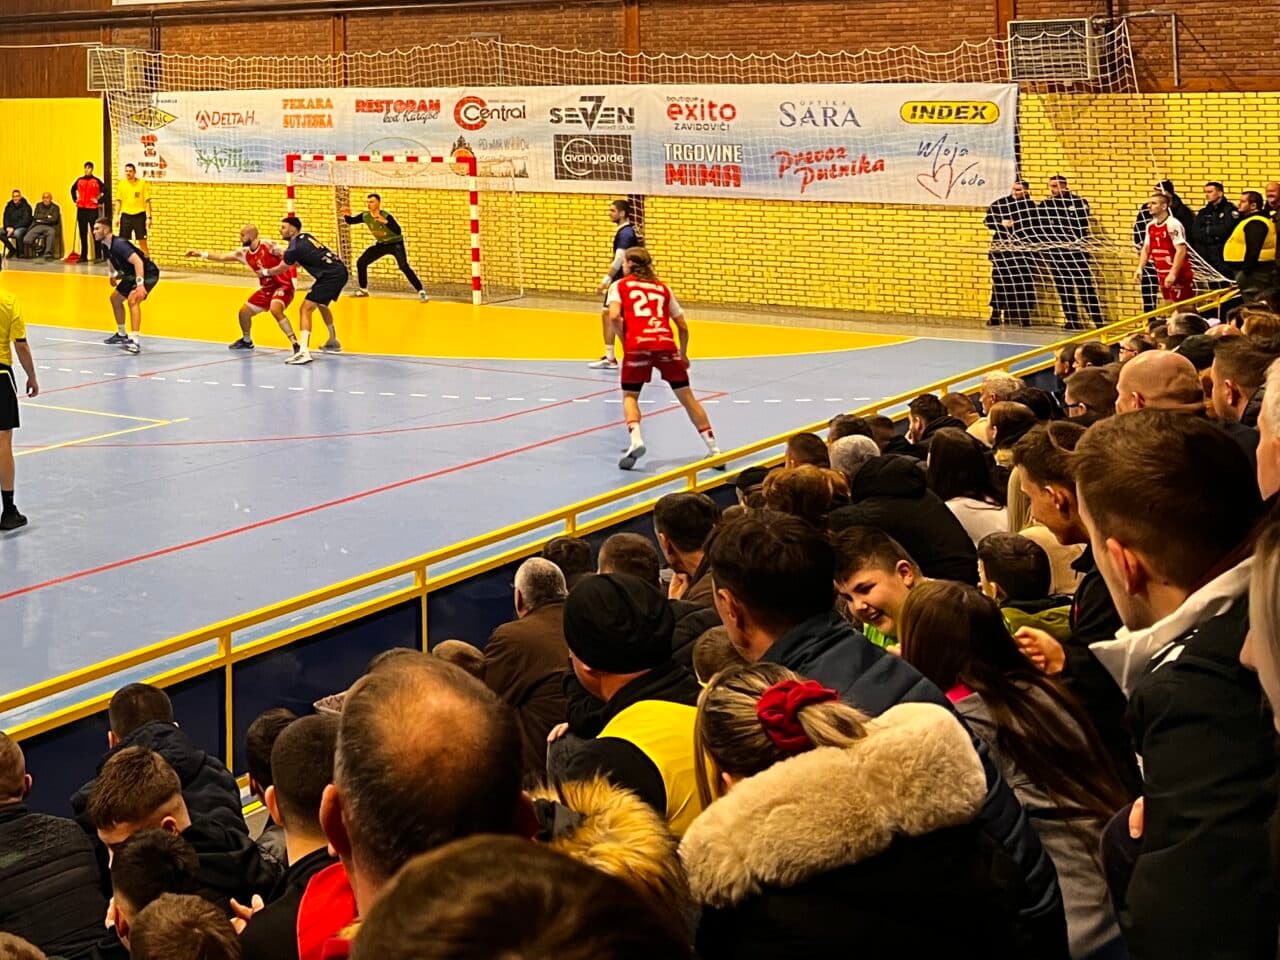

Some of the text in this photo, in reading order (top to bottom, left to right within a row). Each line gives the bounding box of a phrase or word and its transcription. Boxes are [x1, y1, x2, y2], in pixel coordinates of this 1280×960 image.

[282, 98, 334, 109] PEKARA
[355, 99, 440, 113] RESTORAN
[463, 105, 526, 121] Central
[667, 99, 736, 122] exito
[910, 105, 988, 120] INDEX
[779, 101, 862, 127] SARA
[664, 143, 742, 162] TRGOVINE
[665, 163, 741, 186] MIMA
[629, 289, 664, 318] 27
